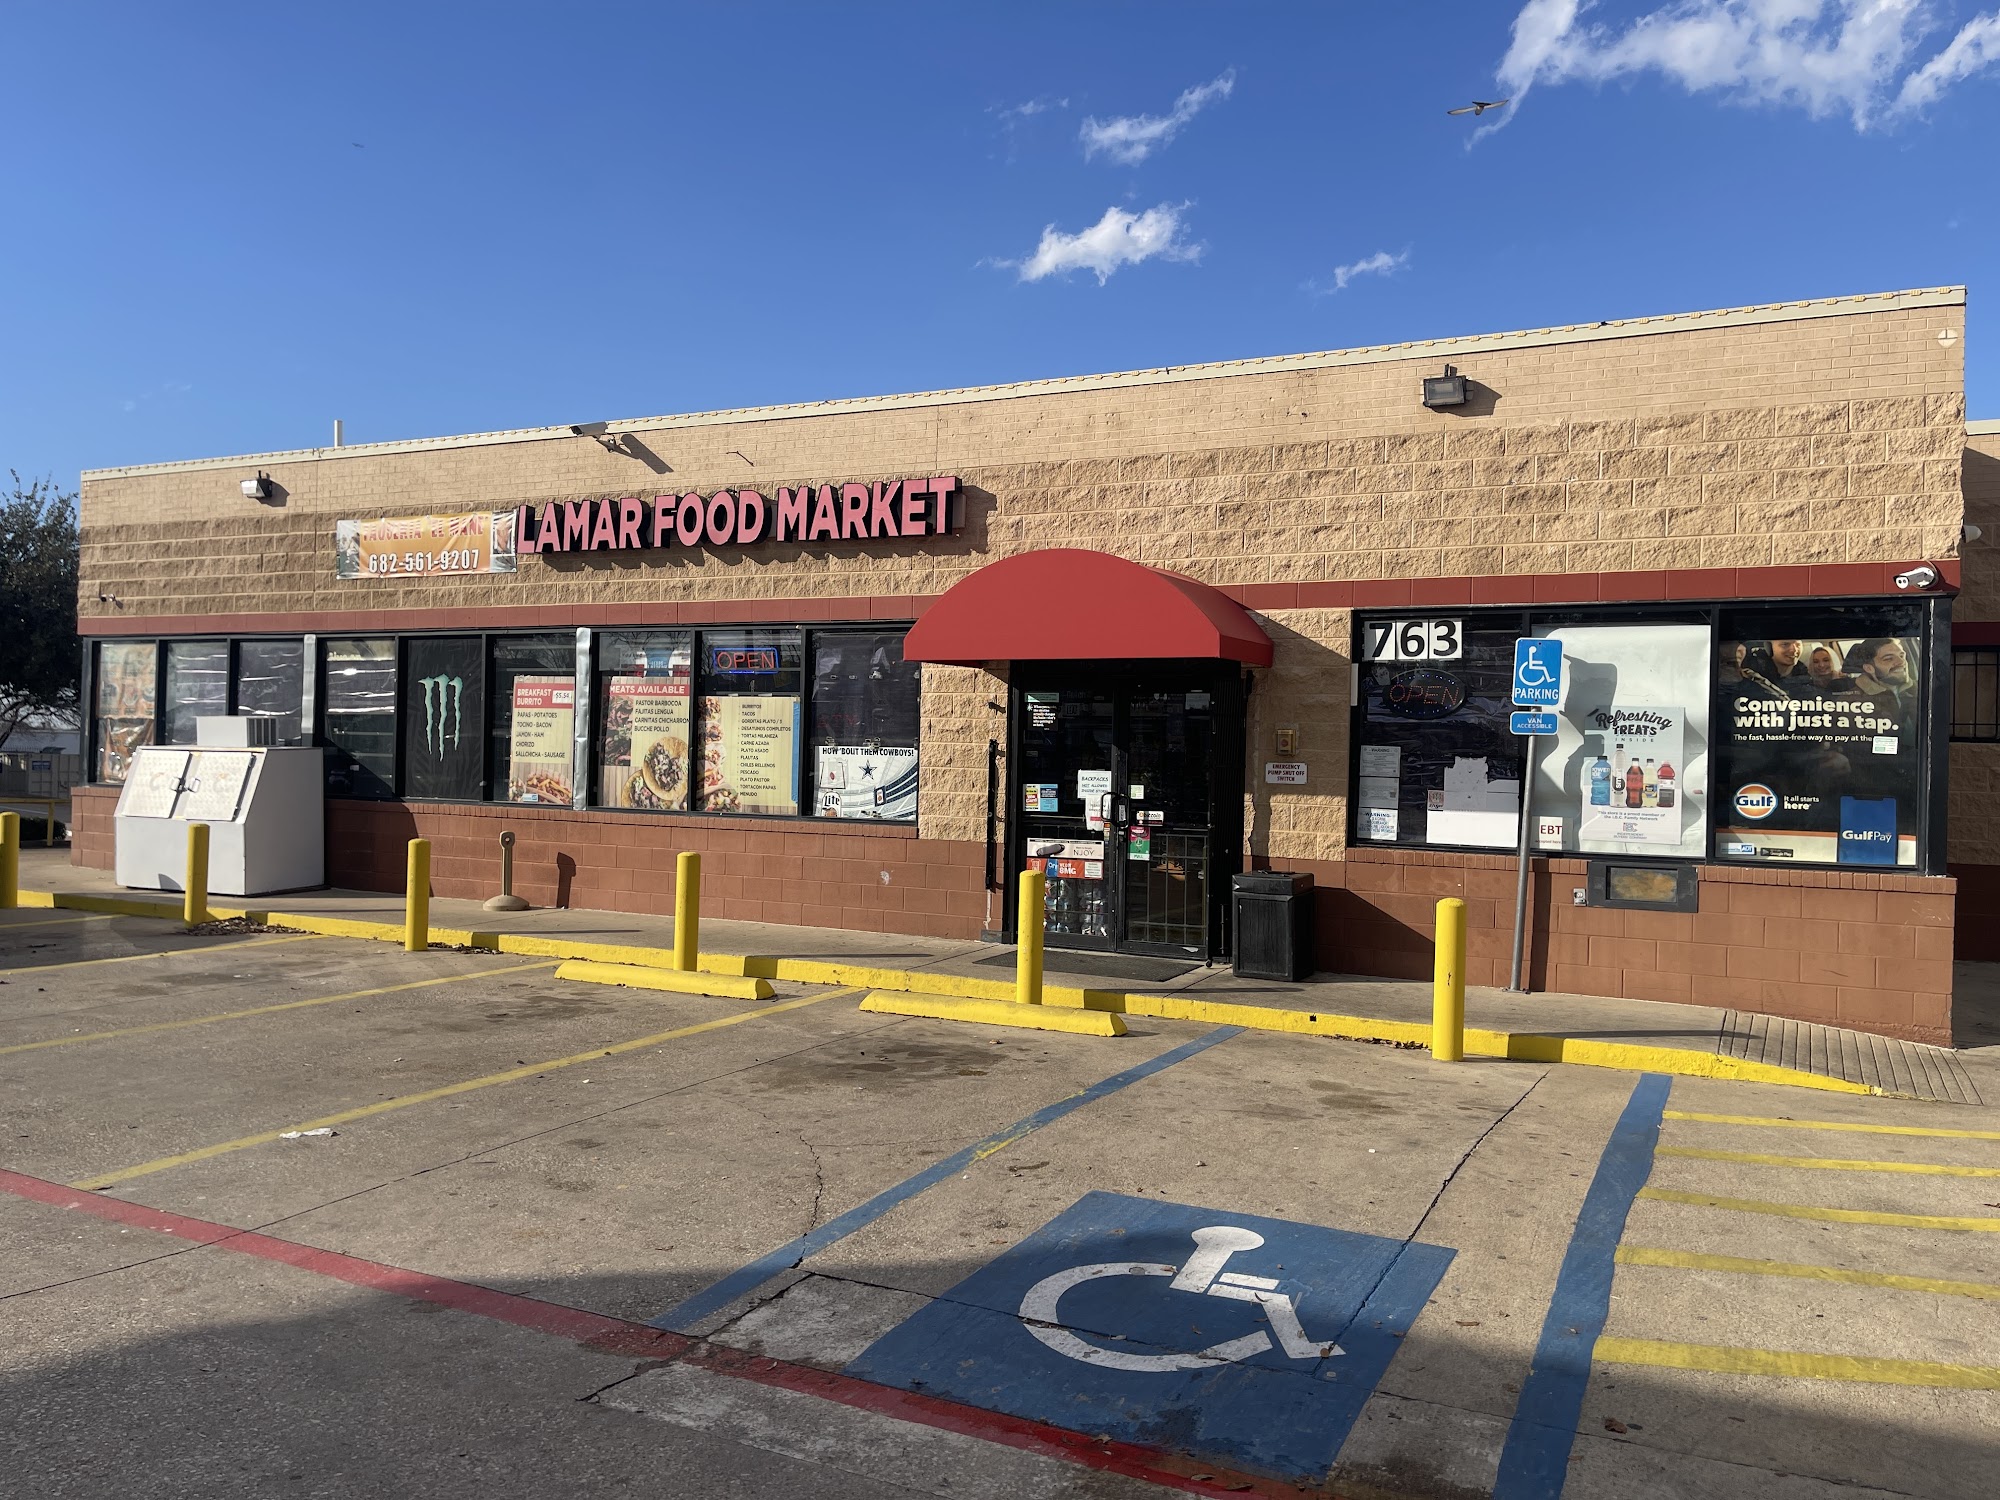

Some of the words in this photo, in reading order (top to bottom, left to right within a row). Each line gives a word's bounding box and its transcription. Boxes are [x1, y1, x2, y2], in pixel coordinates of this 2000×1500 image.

[517, 498, 646, 555] LAMAR
[653, 488, 767, 548] FOOD
[776, 475, 957, 542] MARKET
[369, 549, 479, 574] 682-561-9207
[1369, 619, 1459, 658] 763
[717, 651, 775, 669] OPEN
[517, 688, 552, 697] BREAKFAST
[609, 685, 636, 694] MEATS
[637, 685, 686, 694] AVAILABLE
[1389, 683, 1460, 706] OPEN
[1514, 687, 1559, 700] PARKING
[516, 697, 543, 706] BURRITO
[1734, 696, 1875, 713] Convenience
[1594, 709, 1673, 730] Refreshing
[1734, 711, 1784, 728] with
[1788, 710, 1833, 732] just
[1837, 716, 1850, 728] a
[1854, 715, 1899, 734] tap.
[1612, 724, 1658, 736] TREATS
[1734, 733, 1747, 741] The
[1748, 733, 1765, 742] fast,
[1765, 733, 1807, 741] hassle-free
[1807, 735, 1823, 743] way
[1834, 735, 1849, 743] pay
[543, 751, 566, 759] SAUSAGE
[822, 747, 838, 755] HOW
[861, 748, 879, 756] THEM
[879, 748, 914, 757] COWBOYS!
[825, 794, 840, 807] Lite
[1735, 795, 1774, 807] Gulf
[1783, 801, 1811, 810] here
[1540, 824, 1563, 835] EBT
[1841, 829, 1893, 843] GulfPay
[1073, 849, 1095, 857] NJOY
